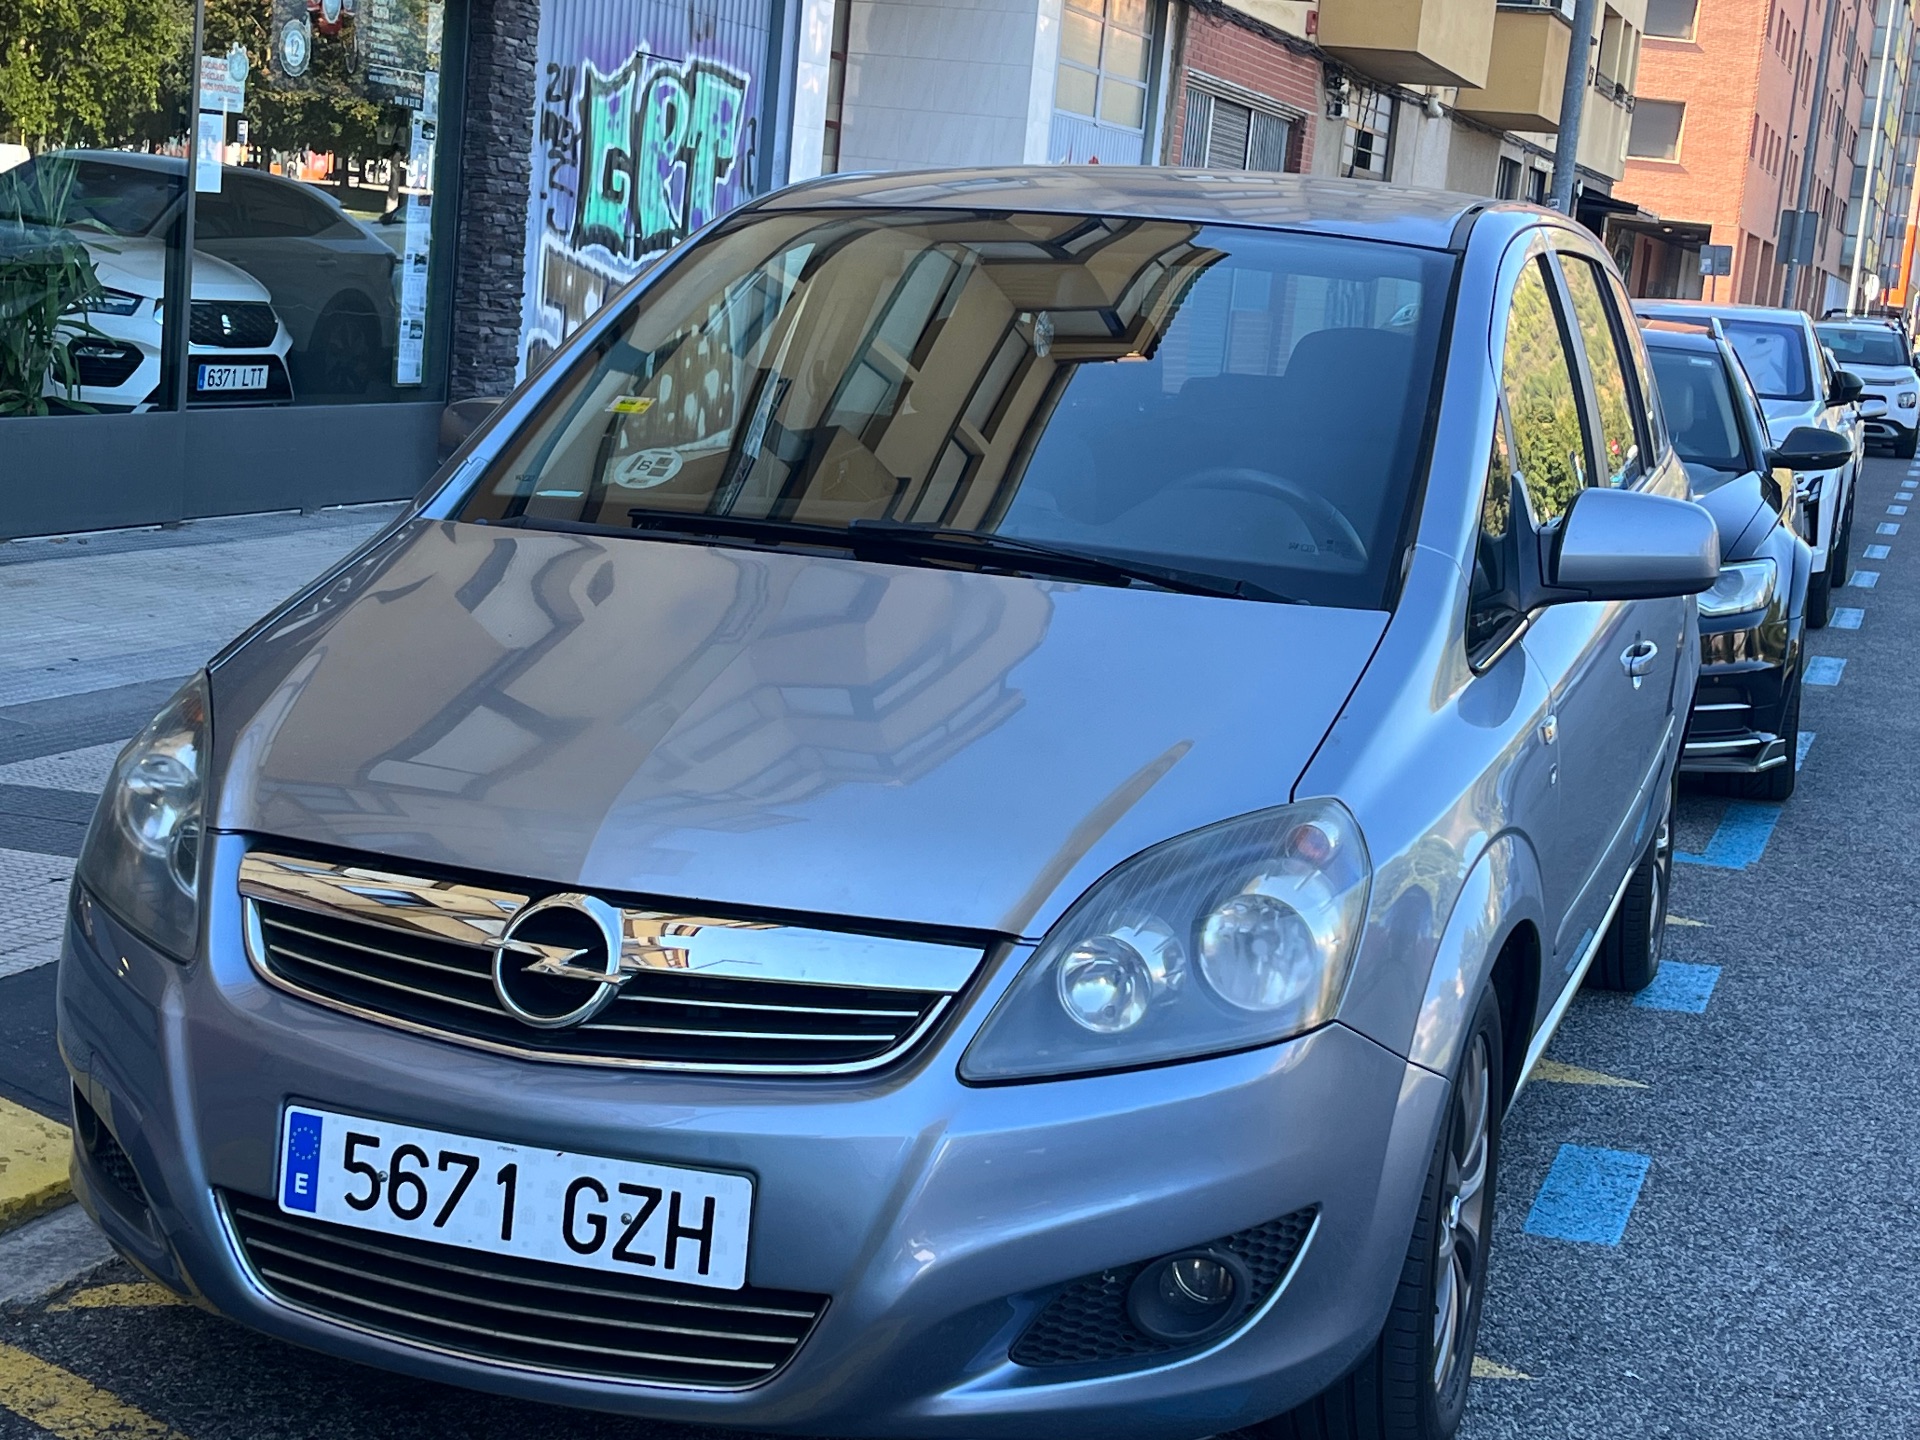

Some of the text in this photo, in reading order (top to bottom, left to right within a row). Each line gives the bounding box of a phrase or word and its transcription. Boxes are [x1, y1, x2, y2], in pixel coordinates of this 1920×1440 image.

[208, 367, 264, 387] 6371 LTT
[294, 1131, 716, 1276] E 5671 GZH
